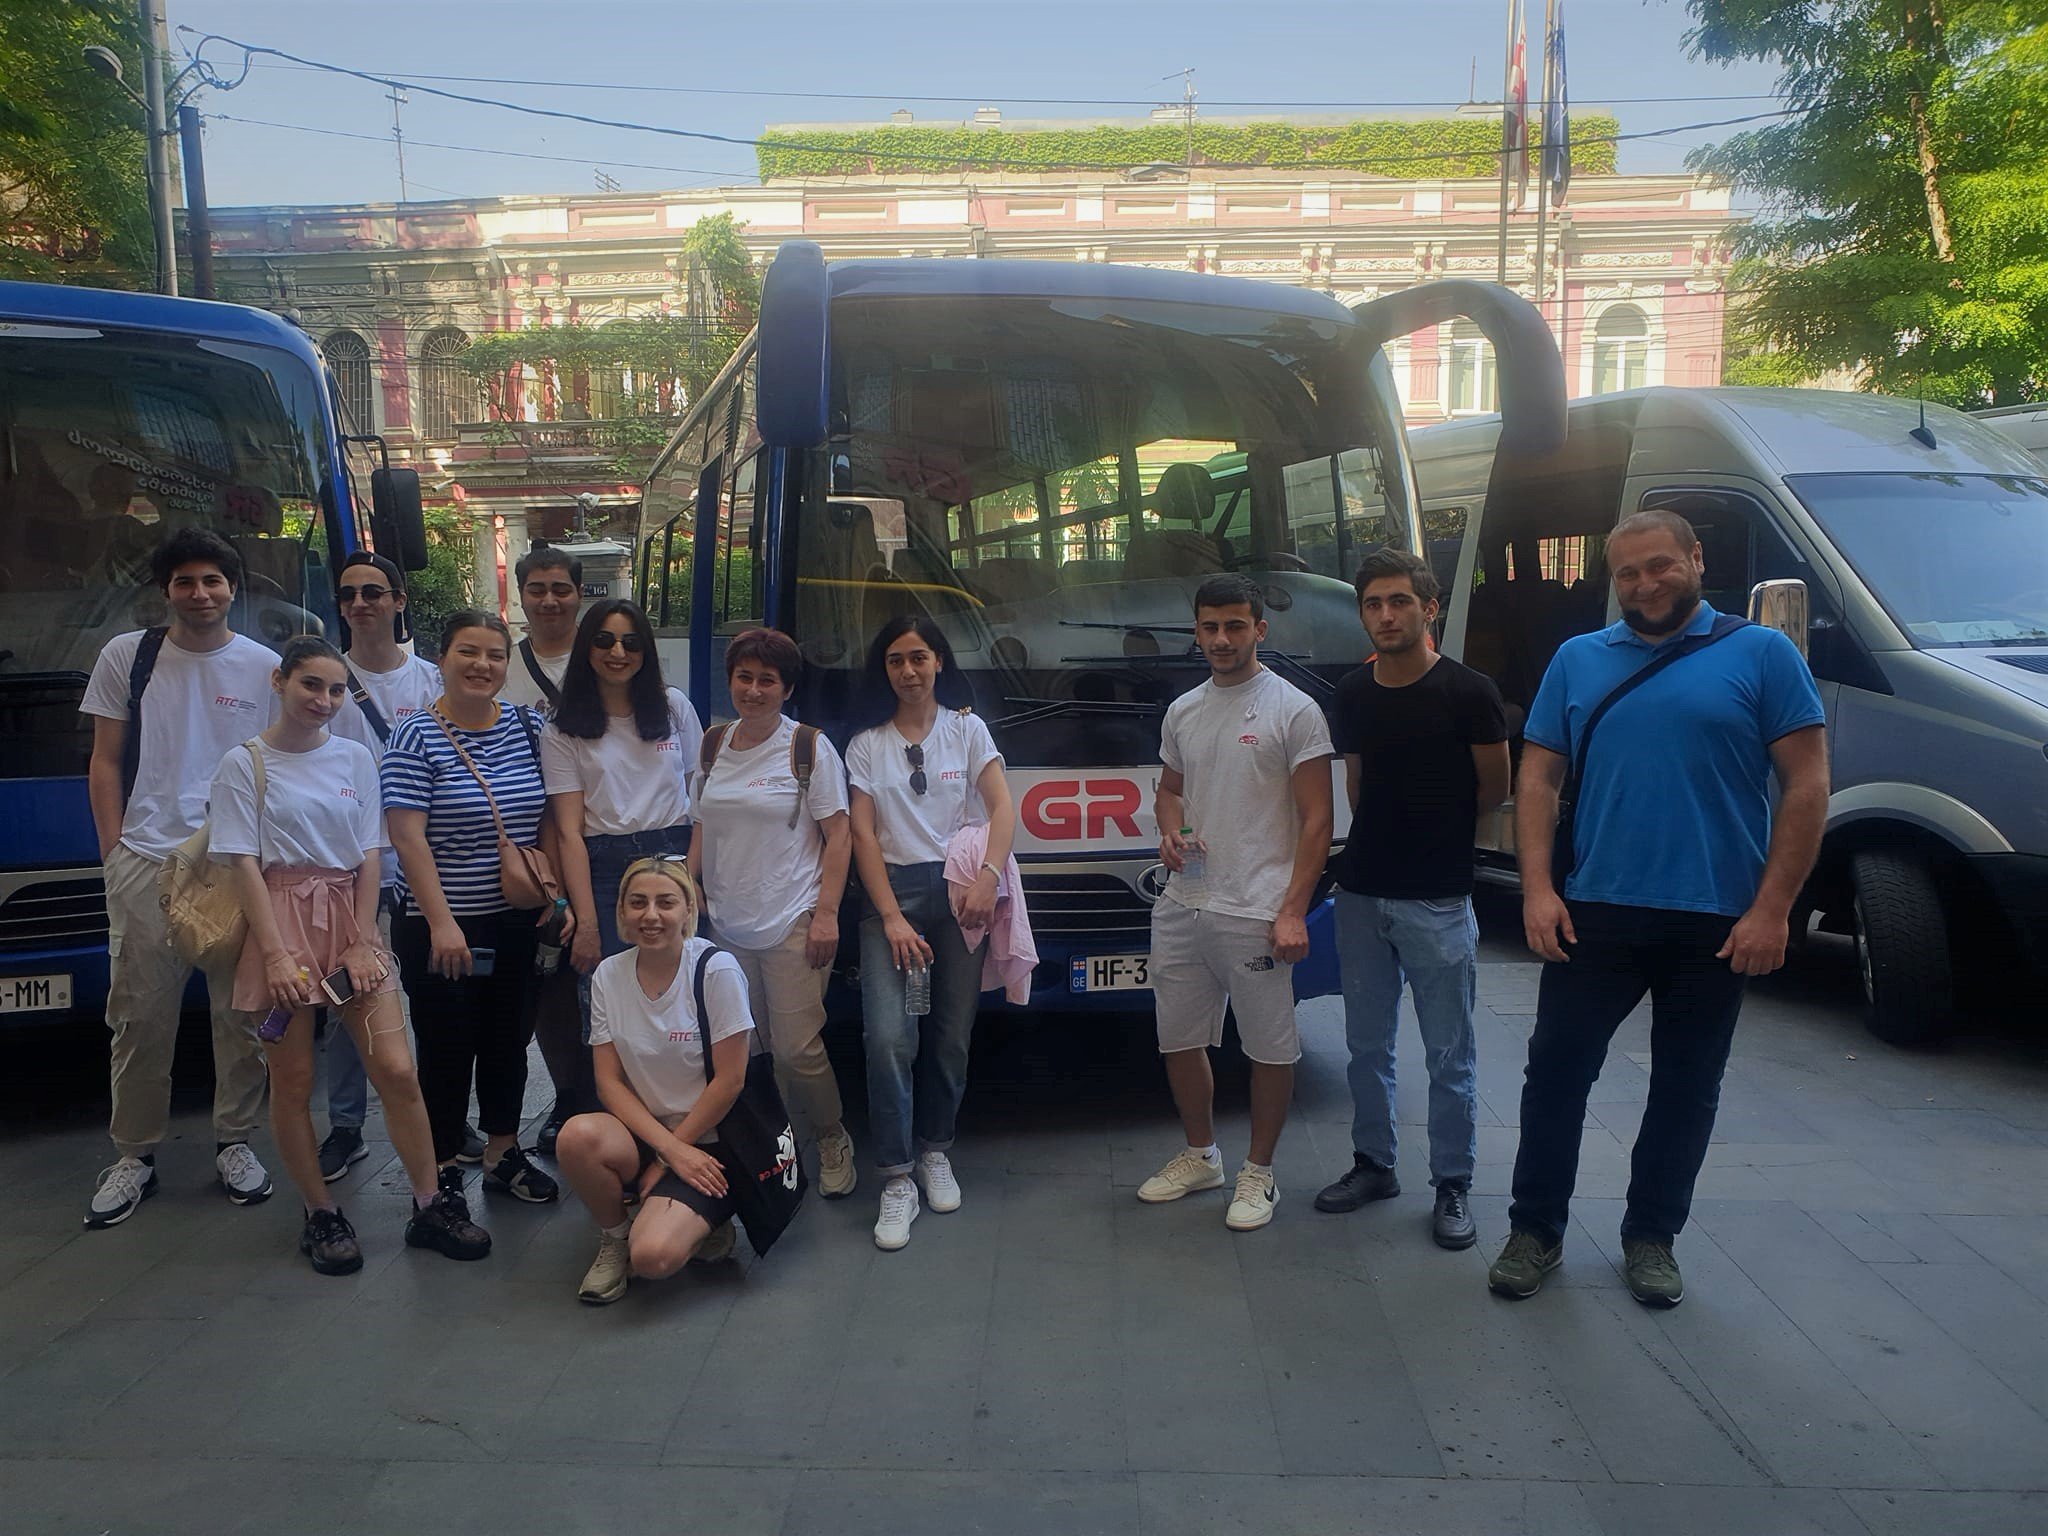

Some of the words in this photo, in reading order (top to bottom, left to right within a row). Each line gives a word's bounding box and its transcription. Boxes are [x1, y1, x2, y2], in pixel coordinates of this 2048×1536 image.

[1021, 778, 1143, 840] GR
[1072, 976, 1085, 988] GE
[1094, 958, 1148, 986] HF-3
